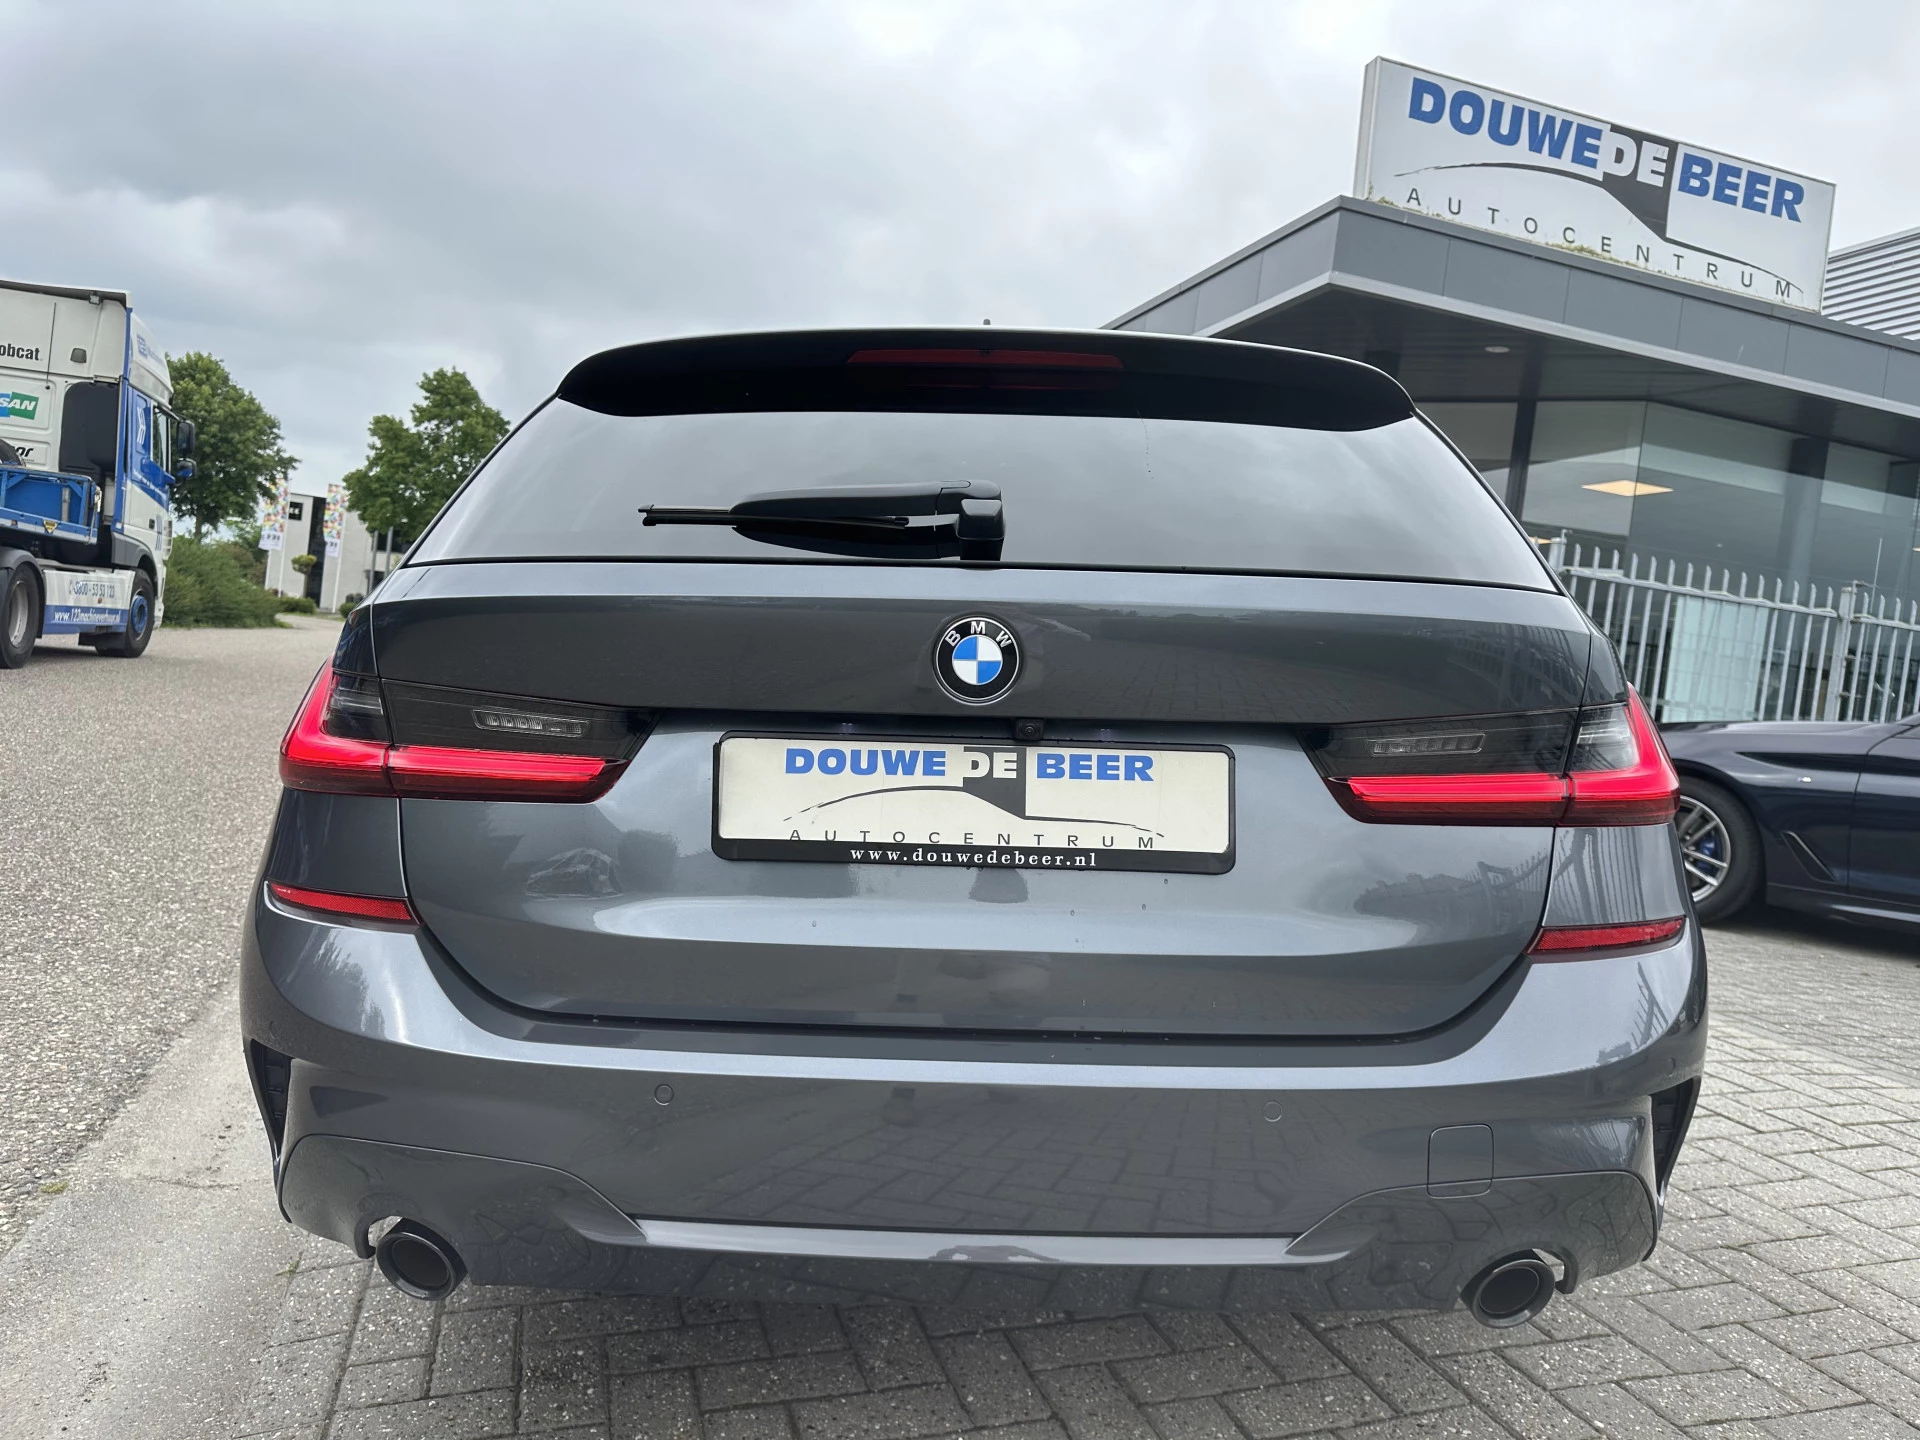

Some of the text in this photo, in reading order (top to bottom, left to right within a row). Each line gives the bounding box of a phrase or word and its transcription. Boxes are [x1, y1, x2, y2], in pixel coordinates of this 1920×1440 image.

[1408, 77, 1805, 224] DOUWE DE BEER
[1406, 187, 1792, 299] AUTOCENTRUM
[944, 620, 1012, 648] BMW
[784, 747, 1154, 782] DOUWE DE BEER
[788, 828, 1154, 850] AUTOCENTRUM
[849, 846, 1097, 868] www.douwedebeer.nl
